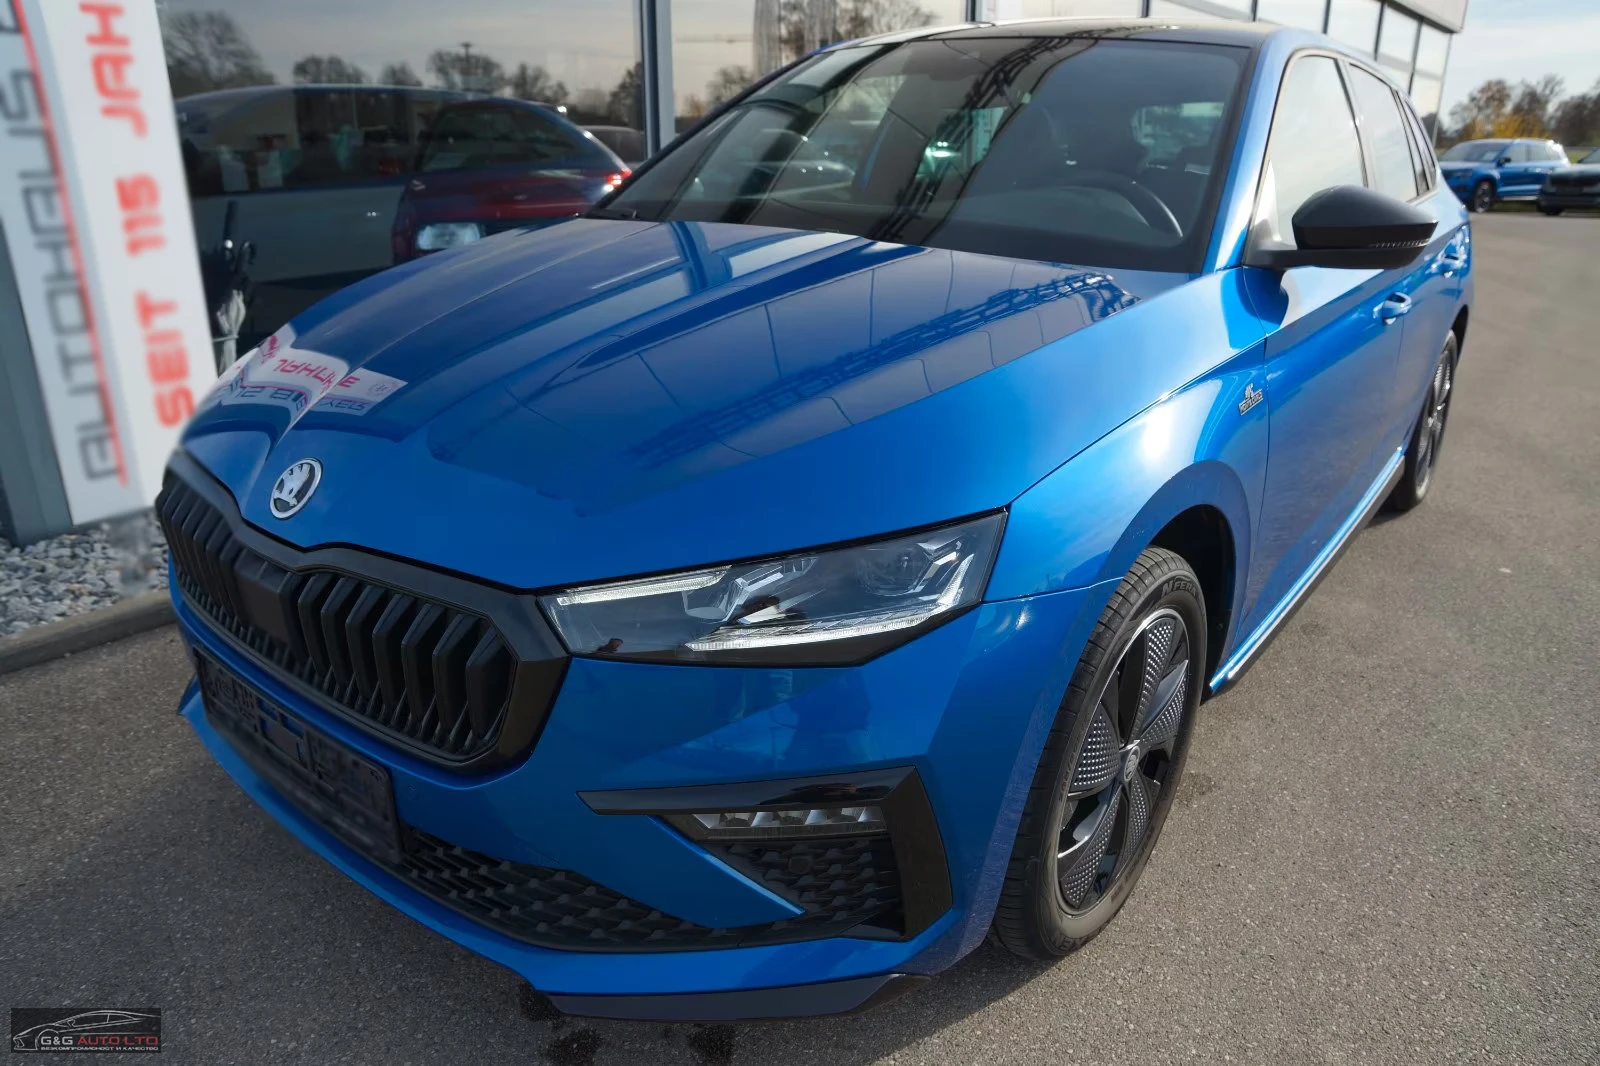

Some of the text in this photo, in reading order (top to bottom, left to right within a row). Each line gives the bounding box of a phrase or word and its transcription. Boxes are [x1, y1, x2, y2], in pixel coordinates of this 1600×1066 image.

[0, 68, 122, 481] AUTOHAUS
[113, 172, 166, 258] 115
[134, 287, 196, 427] SEIT
